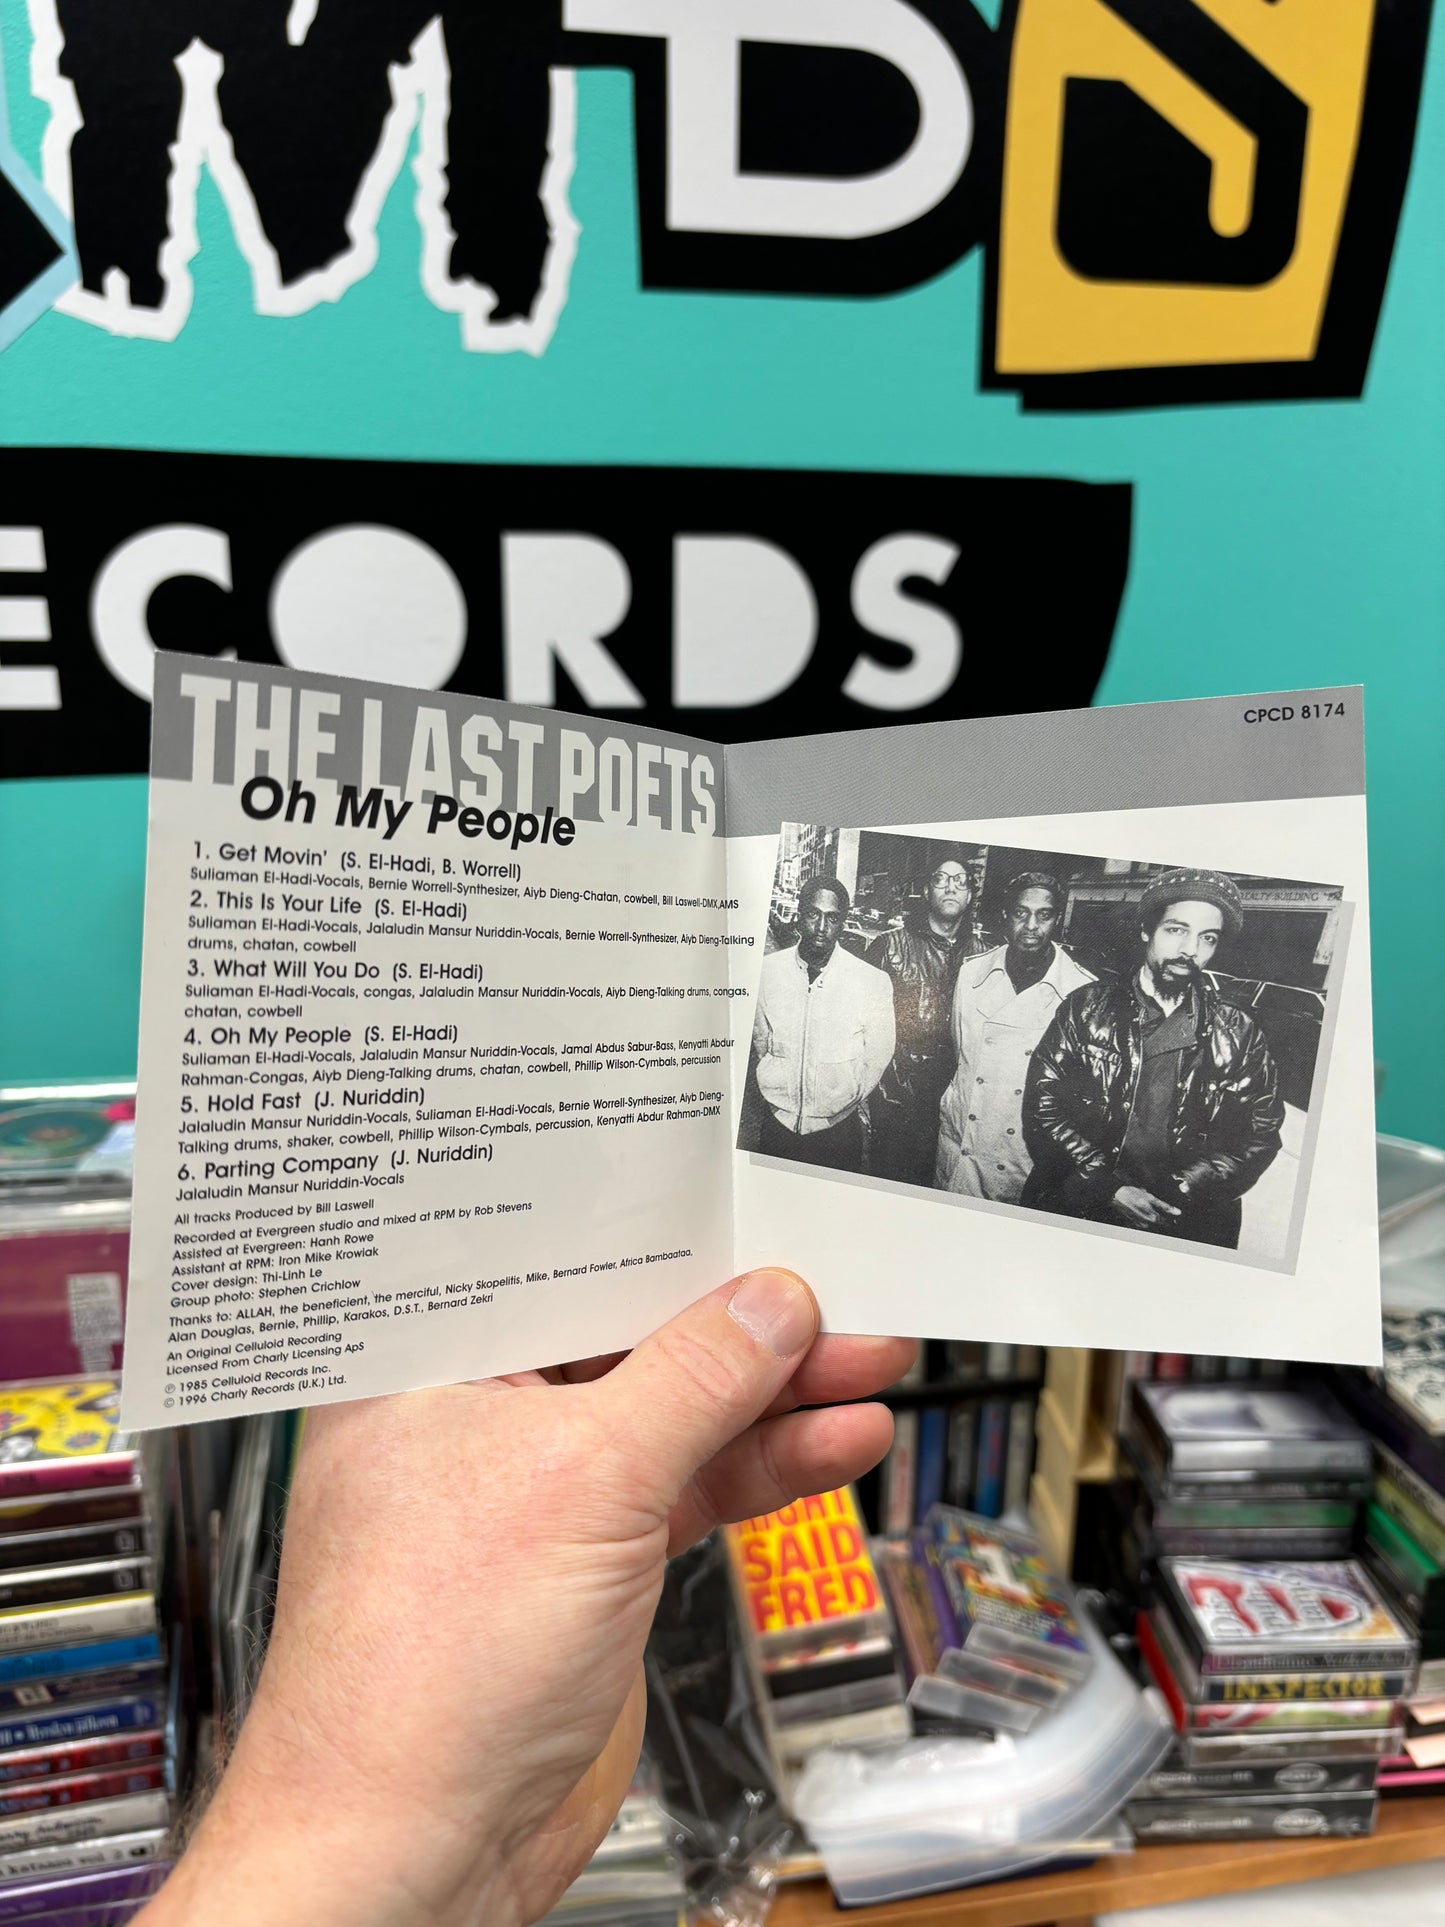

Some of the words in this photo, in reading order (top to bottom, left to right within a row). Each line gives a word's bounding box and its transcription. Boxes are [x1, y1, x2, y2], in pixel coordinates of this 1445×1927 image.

[1243, 706, 1295, 724] CPCD
[1301, 702, 1345, 719] 8174
[181, 673, 341, 796] THE
[362, 697, 545, 814] LAST
[559, 728, 716, 837] POETS
[240, 775, 317, 825] Oh
[335, 785, 414, 840] My
[426, 794, 577, 851] People
[194, 841, 210, 859] 1.
[219, 843, 257, 862] Get
[264, 845, 327, 866] Movin'
[341, 851, 361, 872] (S.
[369, 853, 435, 876] El-Hadi,
[442, 858, 456, 875] B.
[462, 859, 521, 883] Worrell)
[190, 866, 259, 883] Suliaman
[264, 870, 363, 890] El-Hadi-Vocals,
[368, 877, 408, 891] Bernie
[411, 879, 520, 898] Worrell-Synthesizer,
[523, 886, 547, 900] Aiyb
[550, 888, 621, 904] Dieng-Chatan,
[624, 894, 660, 906] cowbell,
[662, 895, 673, 906] Bill
[190, 889, 208, 908] 2.
[217, 890, 253, 910] This
[261, 892, 275, 911] Is
[282, 894, 324, 912] Your
[330, 896, 362, 914] Life
[375, 898, 394, 919] (S.
[402, 900, 467, 922] El-Hadi)
[187, 936, 237, 952] drums,
[243, 938, 298, 953] chatan,
[303, 940, 356, 952] cowbell
[187, 958, 205, 977] 3.
[213, 959, 267, 977] What
[273, 960, 307, 978] Will
[313, 961, 347, 978] You
[354, 962, 380, 979] Do
[393, 962, 412, 983] (S.
[419, 963, 483, 983] El-Hadi)
[185, 984, 253, 997] Suliaman
[259, 985, 358, 999] El-Hadi-Vocals,
[363, 988, 415, 1000] congas,
[419, 986, 474, 998] Jalaludin
[478, 986, 519, 998] Mansur
[522, 986, 603, 998] Nuriddin-Vocals,
[605, 987, 626, 999] Aiyb
[629, 986, 685, 999] Dieng-Talking
[687, 986, 711, 997] drums,
[713, 988, 749, 998] congas,
[184, 1005, 241, 1019] chatan,
[247, 1005, 302, 1018] cowbell
[184, 1027, 202, 1045] 4.
[211, 1027, 240, 1045] Oh
[249, 1027, 278, 1048] My
[285, 1026, 352, 1047] People
[364, 1025, 384, 1046] (S.
[392, 1025, 458, 1044] El-Hadi)
[181, 1071, 307, 1086] Rahman-Congas,
[312, 1069, 342, 1084] Aiyb
[346, 1066, 432, 1083] Dieng-Talking
[436, 1065, 476, 1077] drums,
[480, 1063, 523, 1075] chatan,
[527, 1061, 571, 1073] cowbell,
[574, 1060, 603, 1072] Phillip
[605, 1056, 679, 1070] Wilson-Cymbals,
[681, 1054, 721, 1067] percussion
[178, 1119, 246, 1134] Jalaludin
[251, 1117, 303, 1130] Mansur
[306, 1110, 411, 1127] Nuriddin-Vocals,
[415, 1109, 472, 1121] Suliaman
[475, 1102, 555, 1118] El-Hadi-Vocals,
[559, 1100, 590, 1112] Bernie
[593, 1094, 677, 1110] Worrell-Synthesizer,
[679, 1092, 697, 1105] Aiyb
[699, 1091, 724, 1102] Dieng-
[180, 1096, 198, 1113] 5.
[208, 1093, 254, 1112] Hold
[262, 1092, 301, 1110] Fast
[314, 1090, 334, 1112] (J.
[343, 1087, 425, 1106] Nuriddin)
[177, 1163, 195, 1181] 6.
[205, 1160, 275, 1180] Parting
[282, 1155, 379, 1174] Company
[391, 1149, 409, 1170] (J.
[417, 1143, 493, 1164] Nuriddin)
[176, 1185, 243, 1201] Jalaludin
[248, 1183, 299, 1196] Mansur
[303, 1173, 404, 1192] Nuriddin-Vocals
[174, 1213, 189, 1225] All
[194, 1211, 231, 1224] tracks
[235, 1205, 294, 1220] Produced
[297, 1205, 312, 1216] by
[316, 1202, 331, 1214] Bill
[335, 1198, 374, 1212] Laswell
[174, 1229, 236, 1245] Recorded
[239, 1228, 252, 1239] at
[256, 1224, 315, 1238] Evergreen
[319, 1219, 354, 1232] studio
[357, 1216, 380, 1228] and
[383, 1213, 416, 1225] mixed
[419, 1211, 431, 1222] at
[434, 1209, 455, 1220] RPM
[458, 1208, 472, 1219] by
[474, 1205, 494, 1216] Rob
[496, 1202, 532, 1213] Stevens
[172, 1246, 222, 1261] Assisted
[226, 1244, 239, 1256] at
[243, 1241, 306, 1255] Evergreen:
[310, 1235, 340, 1248] Hanh
[344, 1234, 374, 1244] Rowe
[169, 1313, 212, 1327] Thanks
[216, 1312, 232, 1322] to:
[236, 1306, 275, 1320] ALLAH,
[279, 1304, 299, 1315] the
[302, 1295, 370, 1312] beneficient,
[372, 1292, 392, 1303] the
[395, 1286, 442, 1301] merciful,
[445, 1282, 473, 1294] Nicky
[476, 1275, 523, 1290] Skopelitis,
[526, 1272, 550, 1283] Mike,
[553, 1265, 587, 1279] Bernard
[619, 1257, 643, 1268] Africa
[171, 1281, 209, 1292] Cover
[213, 1275, 258, 1288] design:
[262, 1269, 305, 1283] Thi-Linh
[309, 1268, 323, 1278] Le
[167, 1352, 182, 1361] An
[186, 1345, 231, 1360] Original
[235, 1338, 284, 1353] Celluloid
[287, 1332, 342, 1347] Recording
[179, 1393, 207, 1406] 1996
[211, 1389, 248, 1402] Charly
[251, 1382, 295, 1396] Records
[328, 1375, 347, 1386] Ltd.
[180, 1379, 208, 1392] 1985
[211, 1372, 262, 1388] Celluloid
[265, 1367, 308, 1381] Records
[311, 1365, 331, 1375] Inc.
[743, 1522, 863, 1583] SAID
[751, 1567, 876, 1634] FRED
[1223, 1671, 1386, 1701] INSPECTOR
